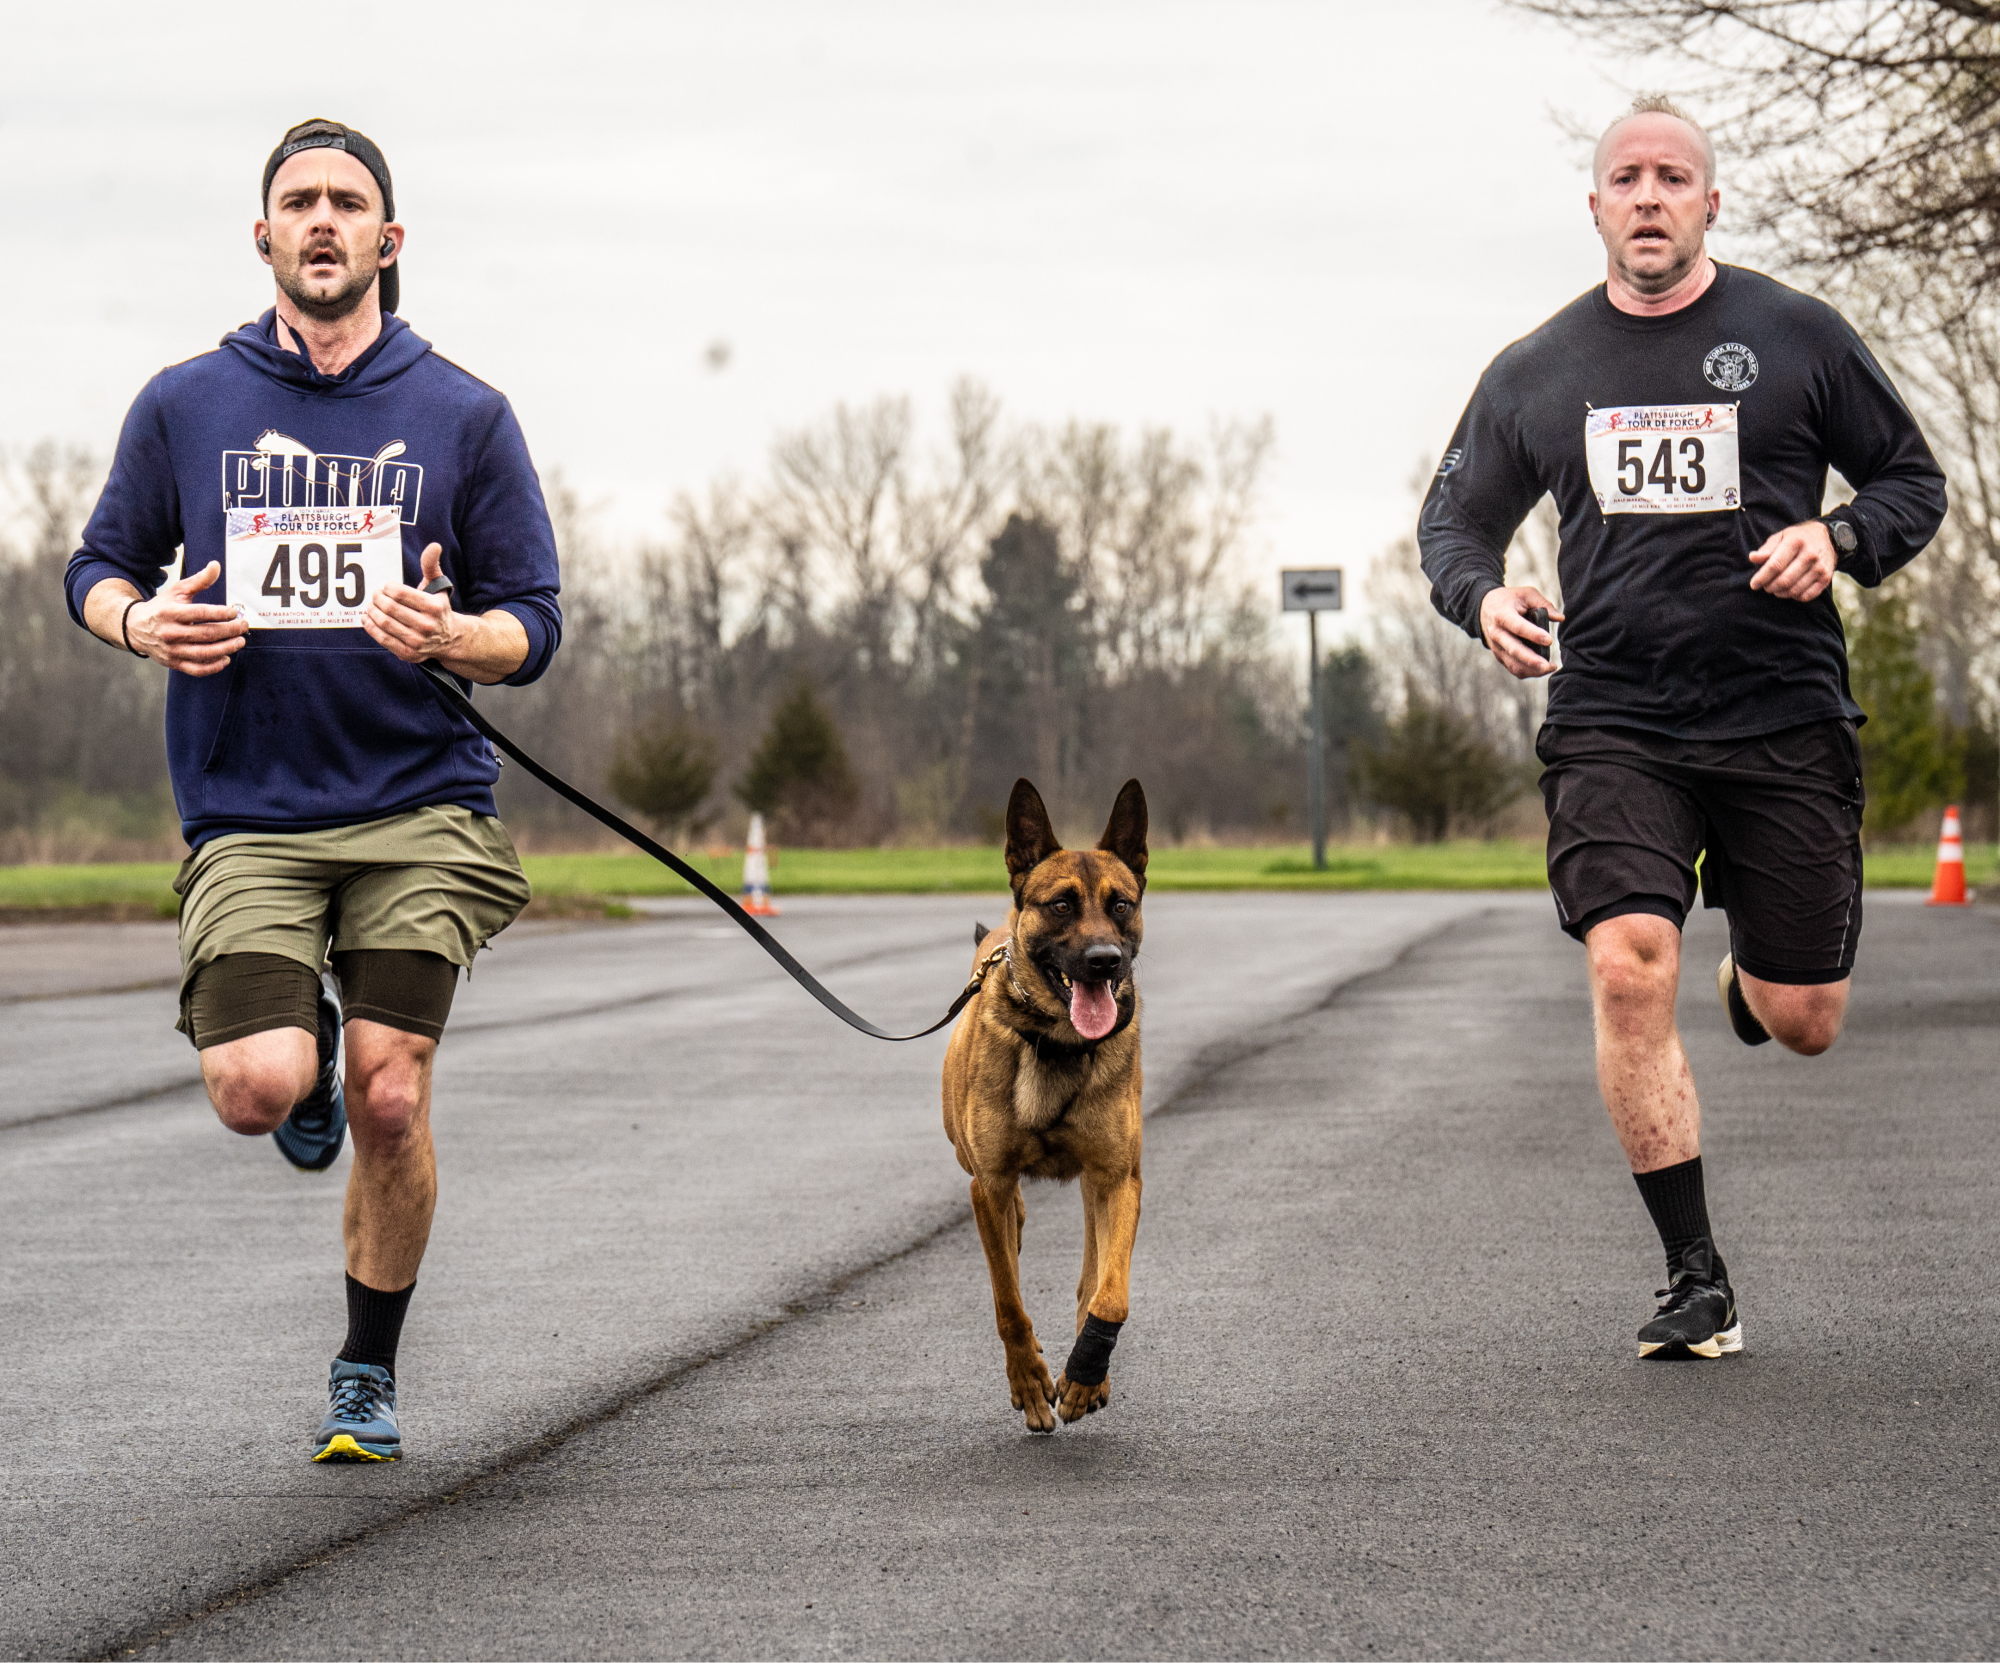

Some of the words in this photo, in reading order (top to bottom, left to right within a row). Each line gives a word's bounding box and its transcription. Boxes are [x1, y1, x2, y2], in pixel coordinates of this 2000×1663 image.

[1634, 411, 1693, 419] PLATTSBURGH
[1670, 418, 1700, 427] FORCE
[1618, 437, 1706, 495] 543
[223, 450, 424, 526] PUMA
[282, 513, 350, 522] PLATTSBURGH
[274, 522, 302, 531] TOUR
[307, 522, 320, 531] DE
[324, 522, 358, 531] FORCE
[261, 543, 365, 608] 495
